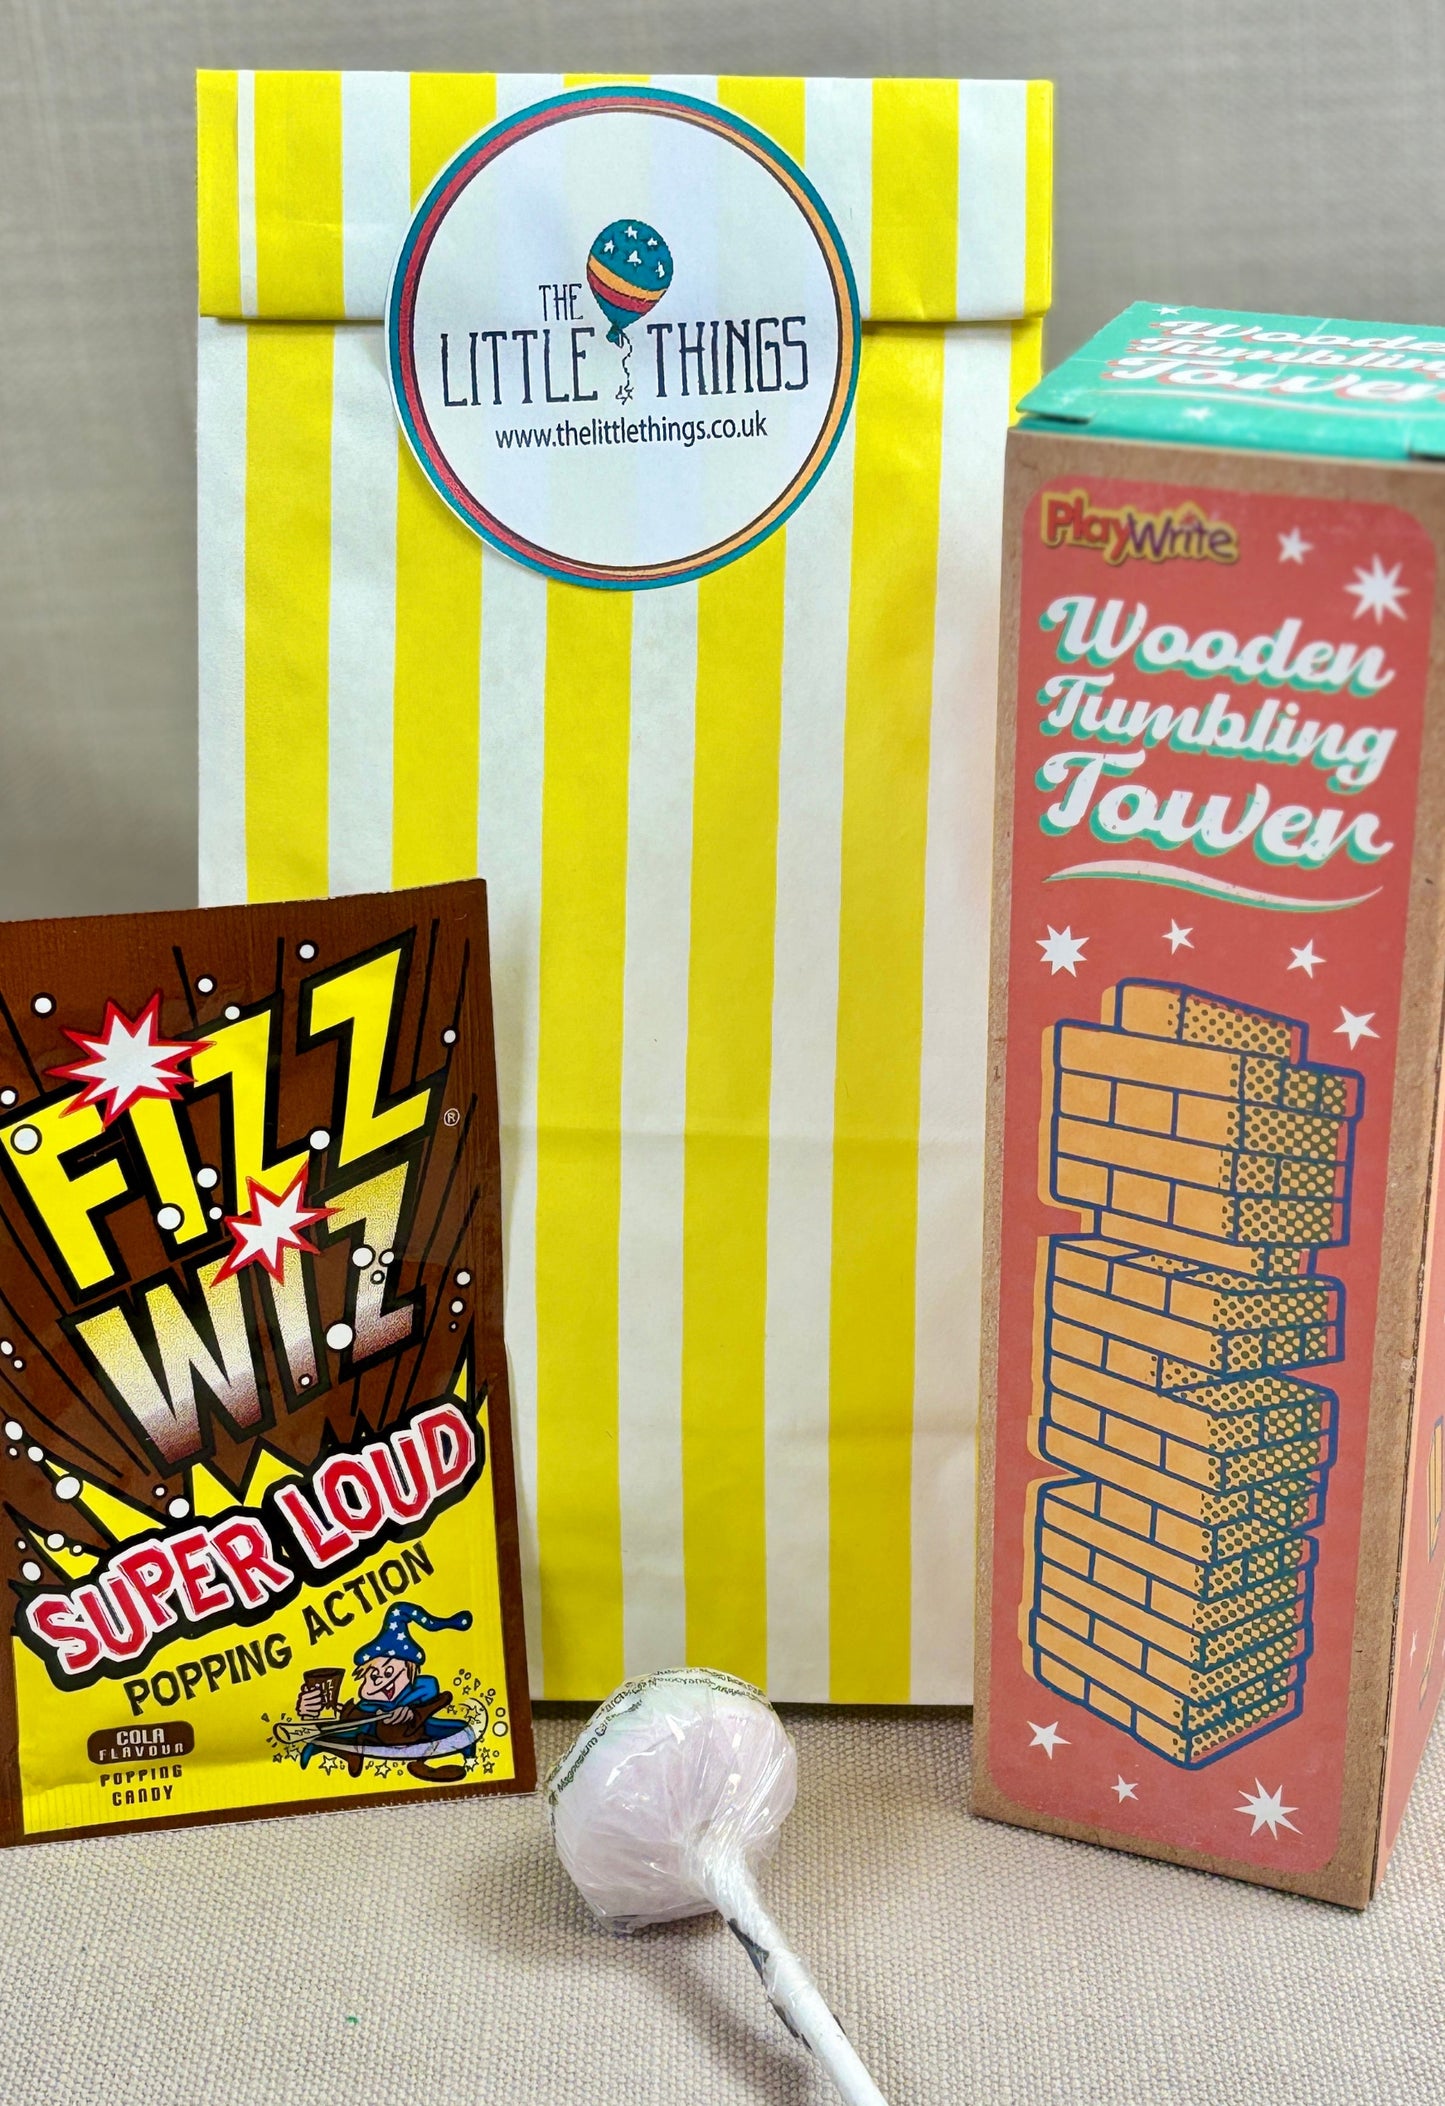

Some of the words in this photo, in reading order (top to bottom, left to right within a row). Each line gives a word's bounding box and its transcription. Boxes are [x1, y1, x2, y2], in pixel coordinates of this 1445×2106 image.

[538, 283, 583, 322] THE
[1155, 319, 1445, 353] Woode
[441, 327, 598, 407] LITTLE
[647, 316, 808, 398] THINGS
[495, 410, 768, 449] www.thelittlethings.co.uk
[1044, 492, 1237, 563] PlayWrite
[1041, 596, 1396, 694] Wooden
[1038, 673, 1397, 792] Tumbling
[1037, 750, 1395, 868] Tower
[0, 946, 432, 1291] FIZZ
[75, 1161, 415, 1465] WIZ
[28, 1516, 294, 1674] SUPER
[275, 1404, 475, 1567] LOUD
[124, 1633, 293, 1716] POPPING
[301, 1543, 434, 1646] ACTION
[99, 1742, 184, 1761] FLAVOUR
[100, 1764, 182, 1788] POPPING
[116, 1728, 165, 1746] COLA
[112, 1785, 173, 1807] CANDY
